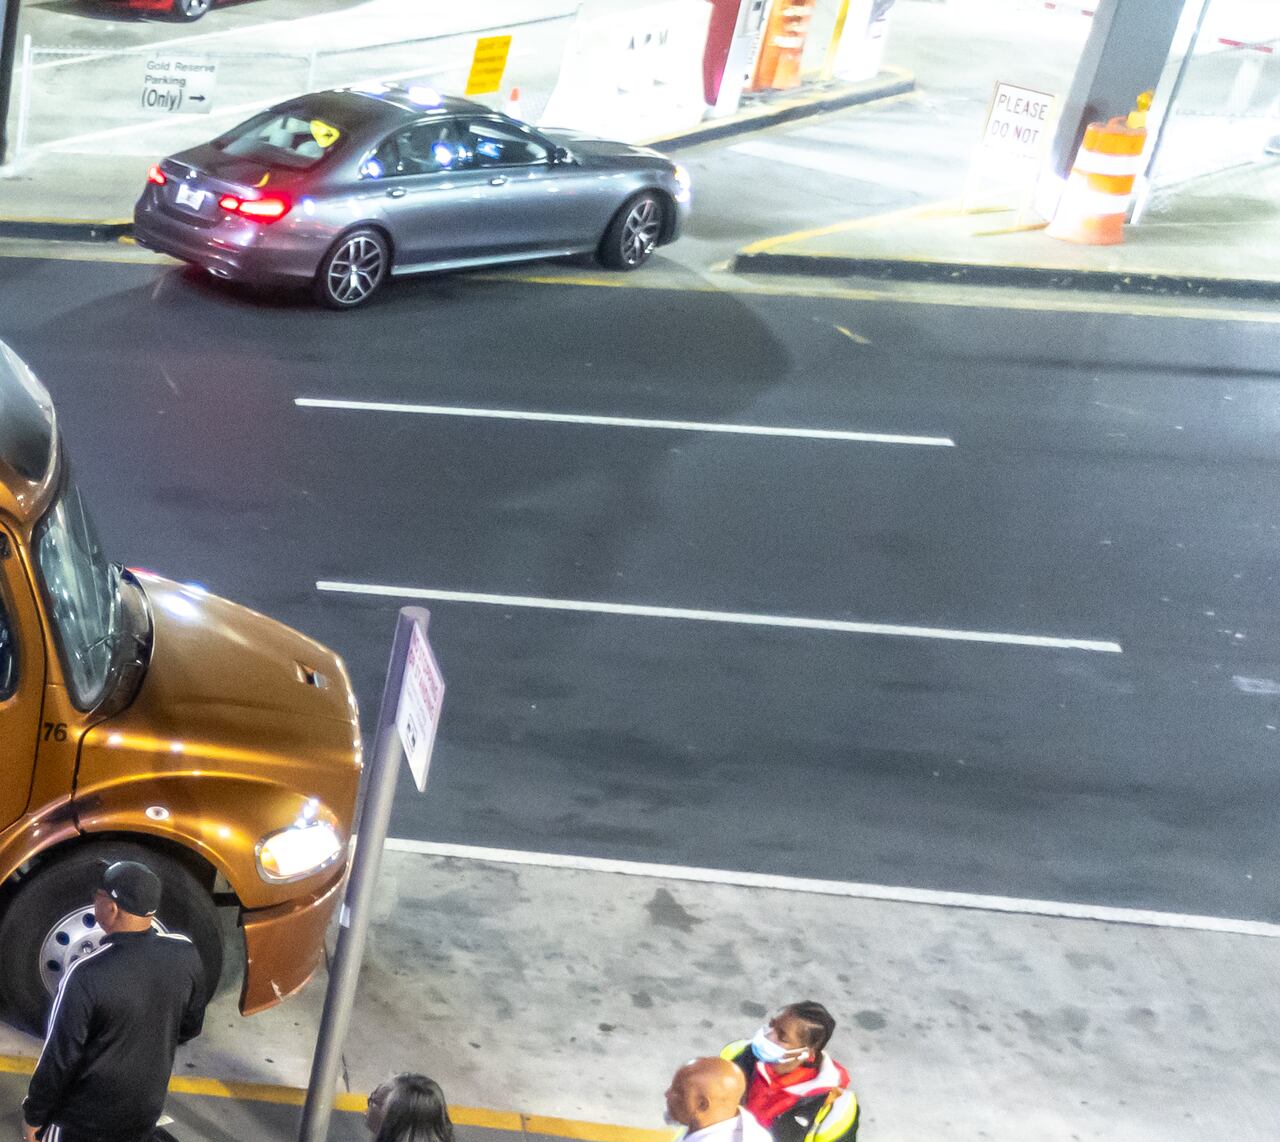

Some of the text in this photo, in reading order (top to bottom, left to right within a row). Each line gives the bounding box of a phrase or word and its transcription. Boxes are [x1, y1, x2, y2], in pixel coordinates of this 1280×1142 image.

[146, 60, 216, 73] Gold Reserve
[144, 75, 187, 88] Parking
[141, 87, 183, 112] (Only)
[998, 93, 1048, 121] PLEASE
[991, 119, 1039, 145] DO NOT
[44, 722, 68, 741] 76
